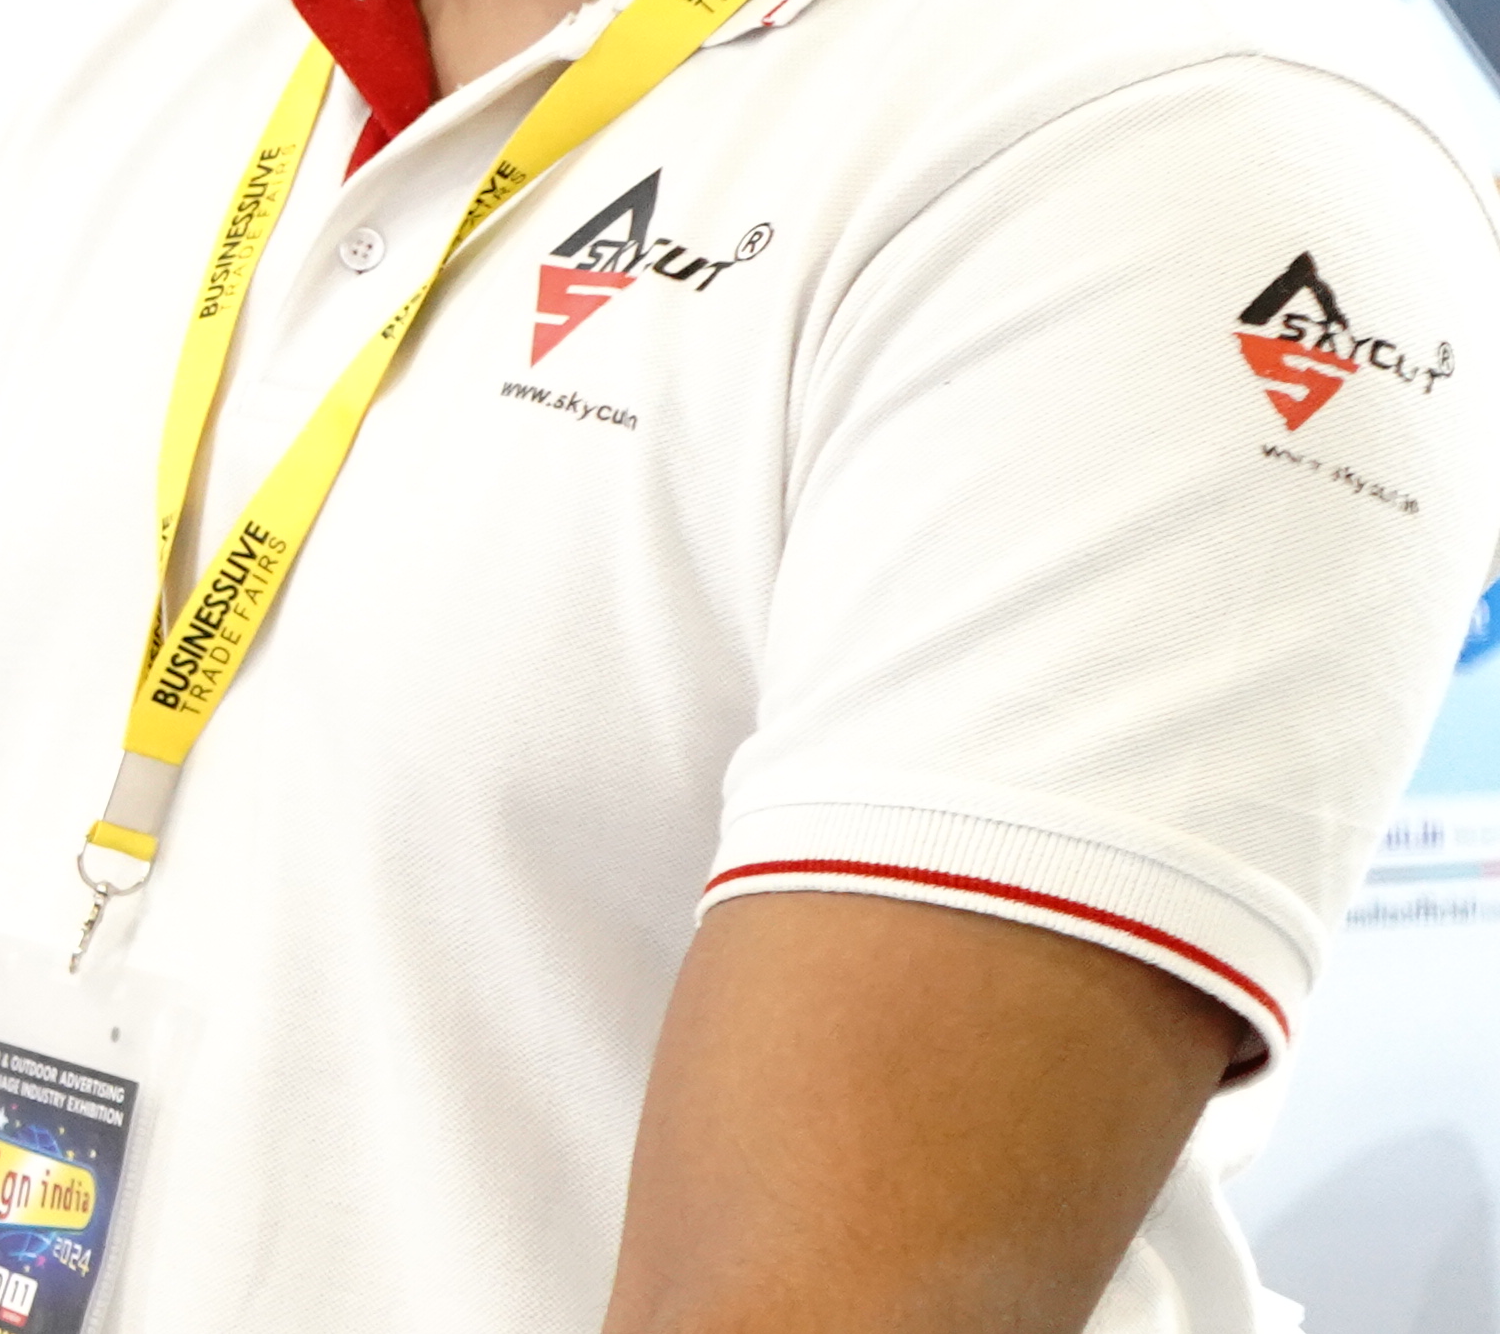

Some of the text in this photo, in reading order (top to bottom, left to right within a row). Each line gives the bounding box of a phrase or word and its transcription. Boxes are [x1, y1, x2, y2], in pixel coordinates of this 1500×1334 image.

[199, 144, 282, 319] BUSINESSLIVE
[219, 141, 298, 313] TRADE FAIRS
[151, 520, 271, 711] BUSINESSLIVE
[179, 534, 287, 716] TRADE FAIRS
[10, 1054, 59, 1083] OUTDOOR
[59, 1070, 126, 1105] ADVERTISING
[20, 1080, 68, 1109] INDUSTRY
[66, 1097, 125, 1128] EXHIBITION
[40, 1169, 92, 1215] india
[52, 1235, 93, 1278] 2024
[10, 1280, 29, 1307] 11
